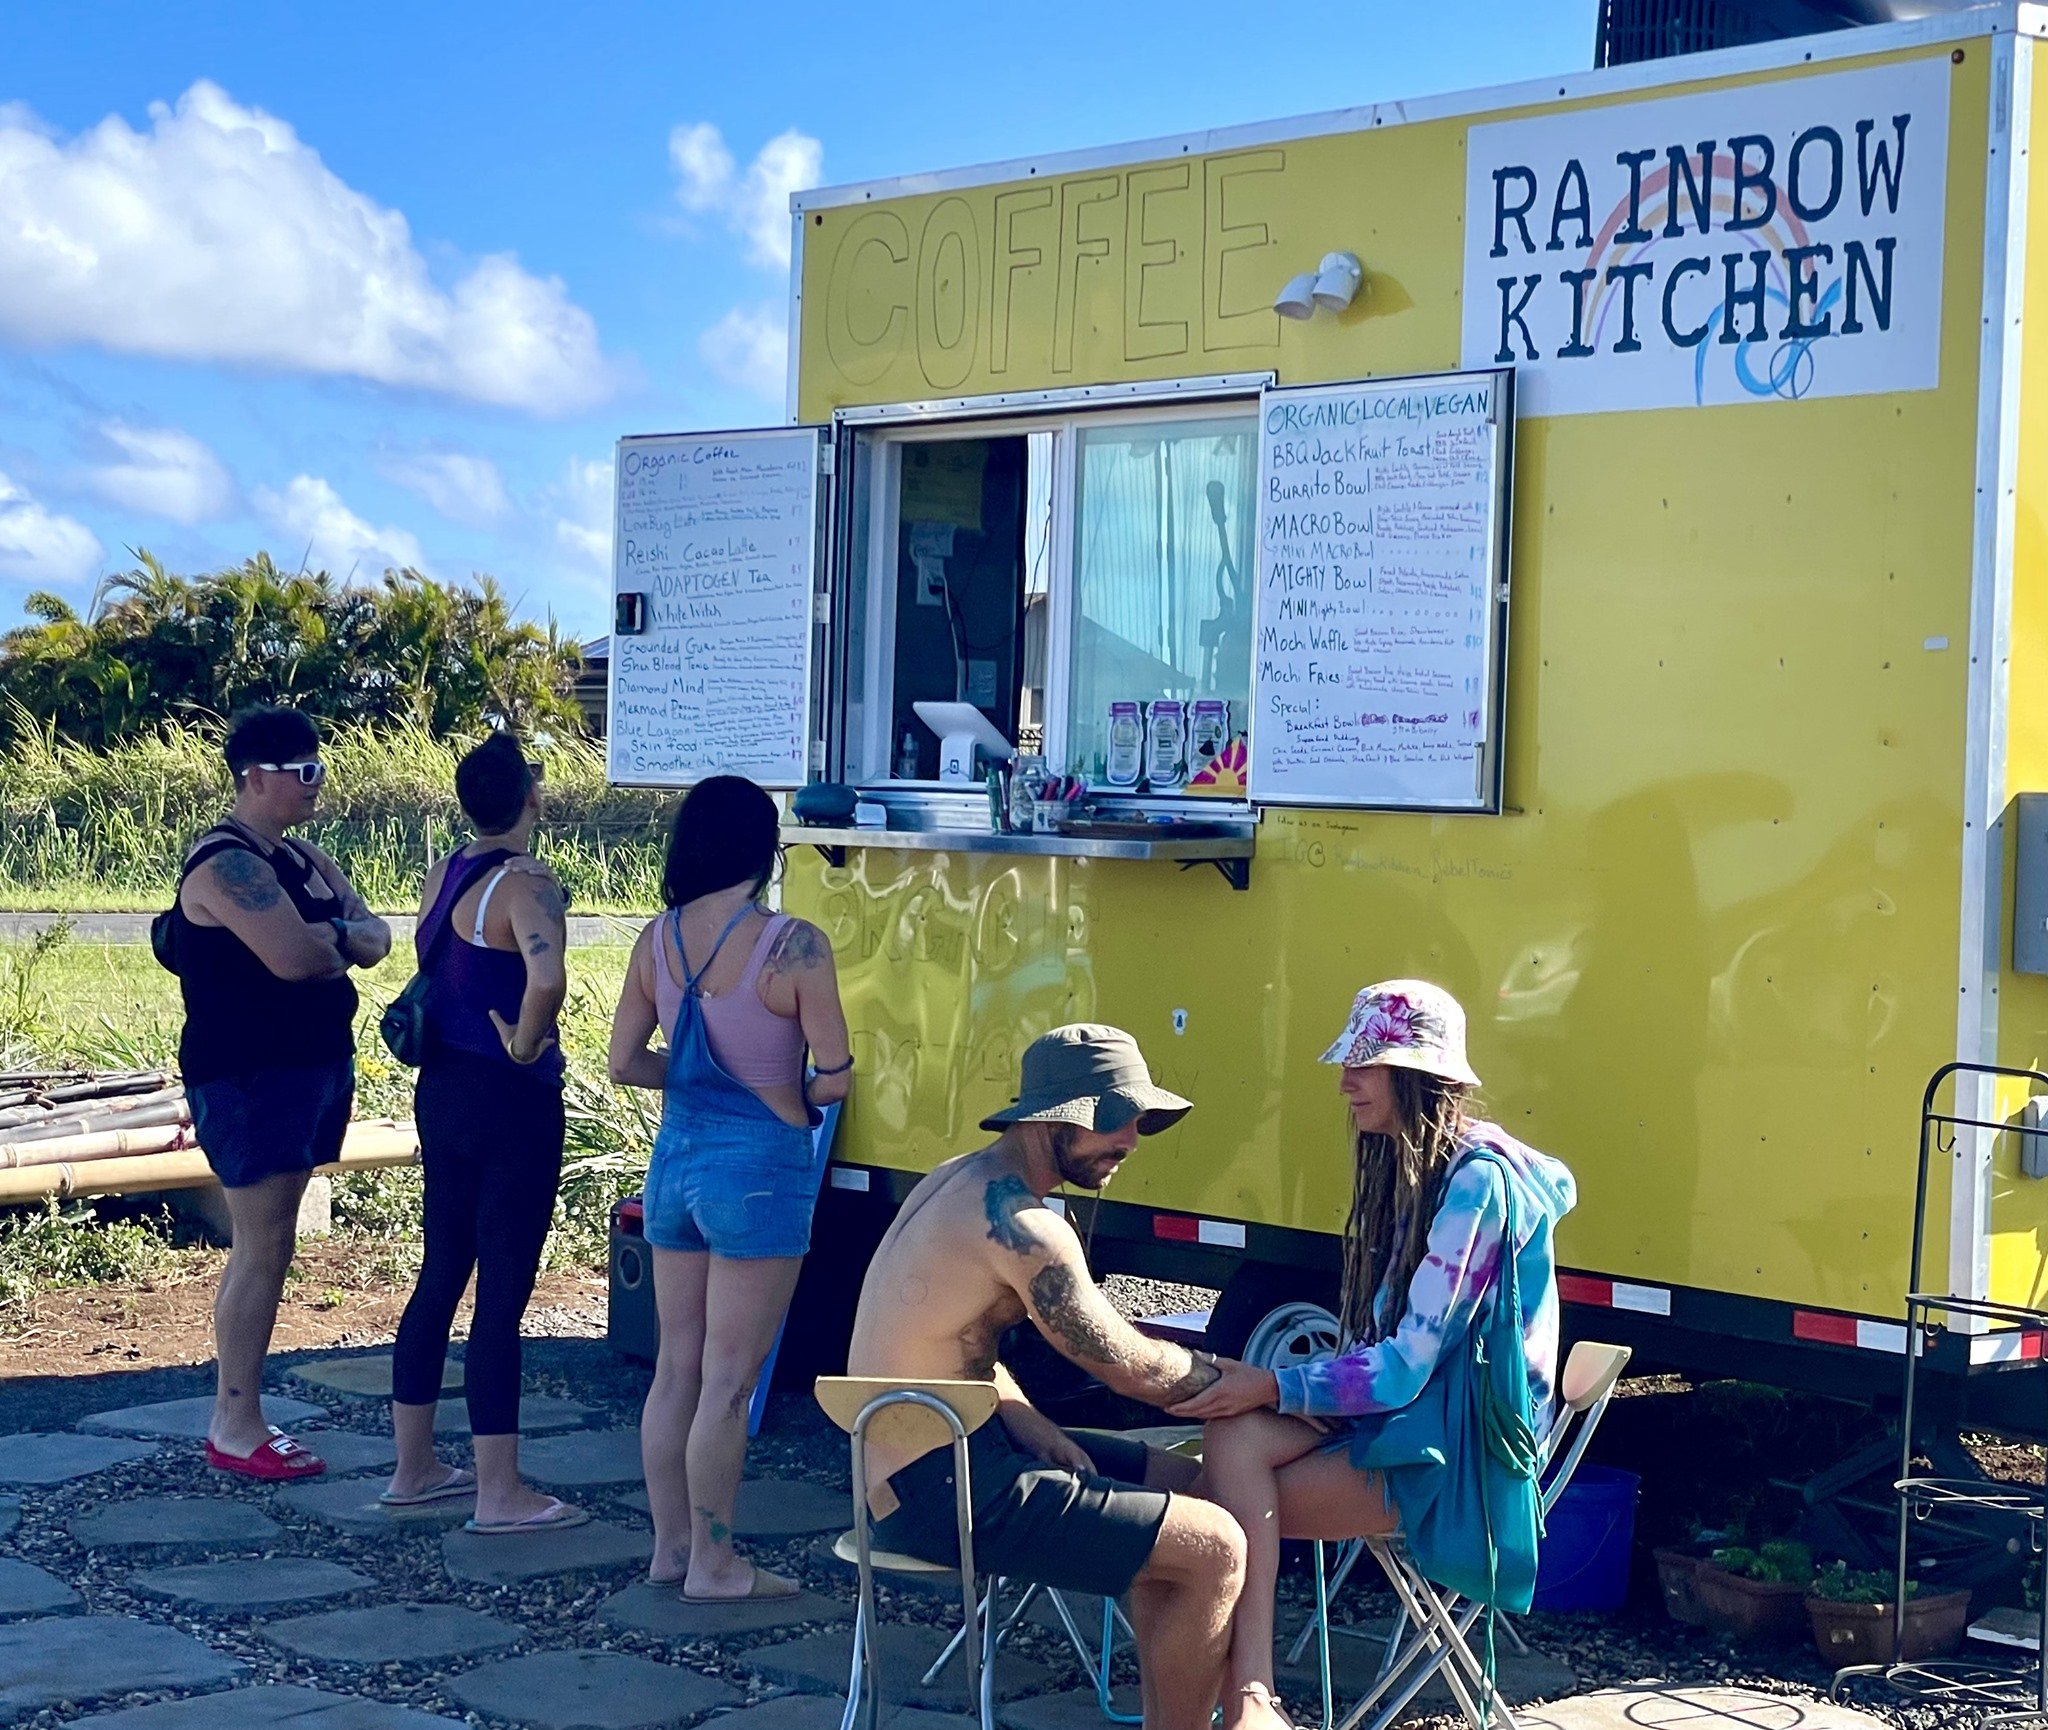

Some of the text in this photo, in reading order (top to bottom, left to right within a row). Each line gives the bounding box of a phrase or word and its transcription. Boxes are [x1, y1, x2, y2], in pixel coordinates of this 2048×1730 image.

[1490, 113, 1911, 258] RAINBOW
[826, 149, 1286, 389] COFFEE
[1494, 237, 1897, 362] KITCHEN
[1425, 390, 1488, 419] VEGAN
[625, 452, 689, 477] Organic
[694, 446, 740, 464] Coffee
[1273, 440, 1309, 469] BBQ
[1396, 434, 1431, 457] Toast
[1334, 468, 1370, 495] Bowl
[1270, 513, 1331, 539] MACRO
[1333, 508, 1373, 535] Bowl
[626, 540, 669, 566] Reishi
[683, 543, 725, 562] Cacao
[728, 537, 757, 556] Latte
[1310, 541, 1352, 562] MACRO
[650, 569, 740, 599] ADAPTOGEN
[748, 569, 773, 584] Tea
[1269, 563, 1325, 593] MIGHTY
[1333, 565, 1372, 593] Bowl
[650, 603, 687, 623] White
[690, 602, 722, 618] Witch
[1279, 597, 1307, 620] MINI
[622, 635, 679, 655] Grounded
[1263, 625, 1349, 652] Mochi Waffle
[652, 656, 682, 672] Blood
[684, 656, 709, 670] Tonic
[1261, 661, 1300, 682] Mochi
[618, 677, 668, 694] Diamond
[672, 677, 704, 695] Mind
[616, 720, 644, 737] Blue
[647, 720, 691, 738] Lagoon
[1285, 717, 1329, 733] Breakfast
[1333, 712, 1357, 729] Bowl
[631, 740, 662, 753] Skin
